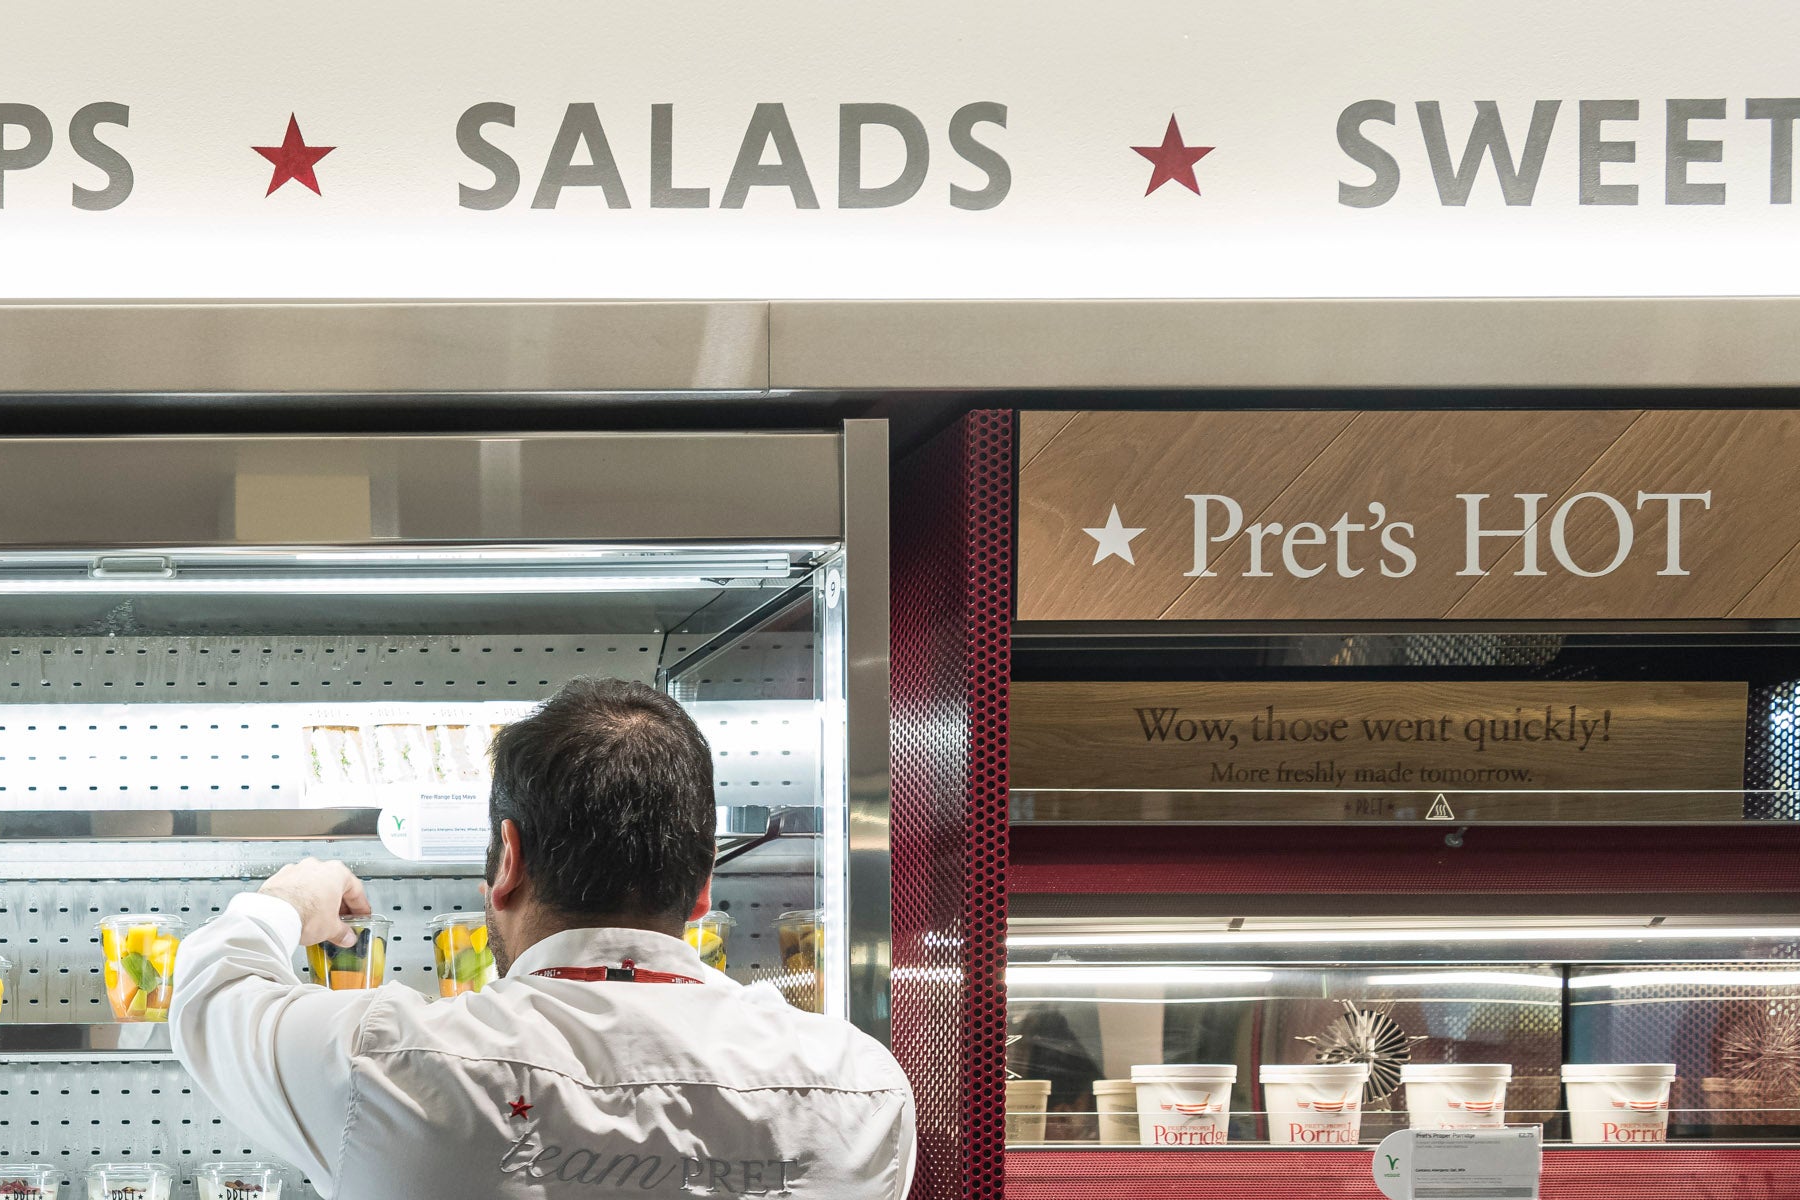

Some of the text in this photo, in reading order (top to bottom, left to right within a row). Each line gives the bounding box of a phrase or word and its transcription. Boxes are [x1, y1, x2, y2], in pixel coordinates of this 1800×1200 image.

[456, 100, 1013, 211] SALADS
[1337, 98, 1800, 209] SWEET
[1182, 490, 1712, 579] Pret's HOT
[1135, 703, 1613, 751] Wow, those went quickly!
[420, 793, 452, 801] Free-Range
[1210, 760, 1533, 788] More freshly made tomorrow.
[1356, 797, 1385, 815] PRET
[500, 1117, 798, 1194] team PRET
[1153, 1124, 1228, 1145] Porridg
